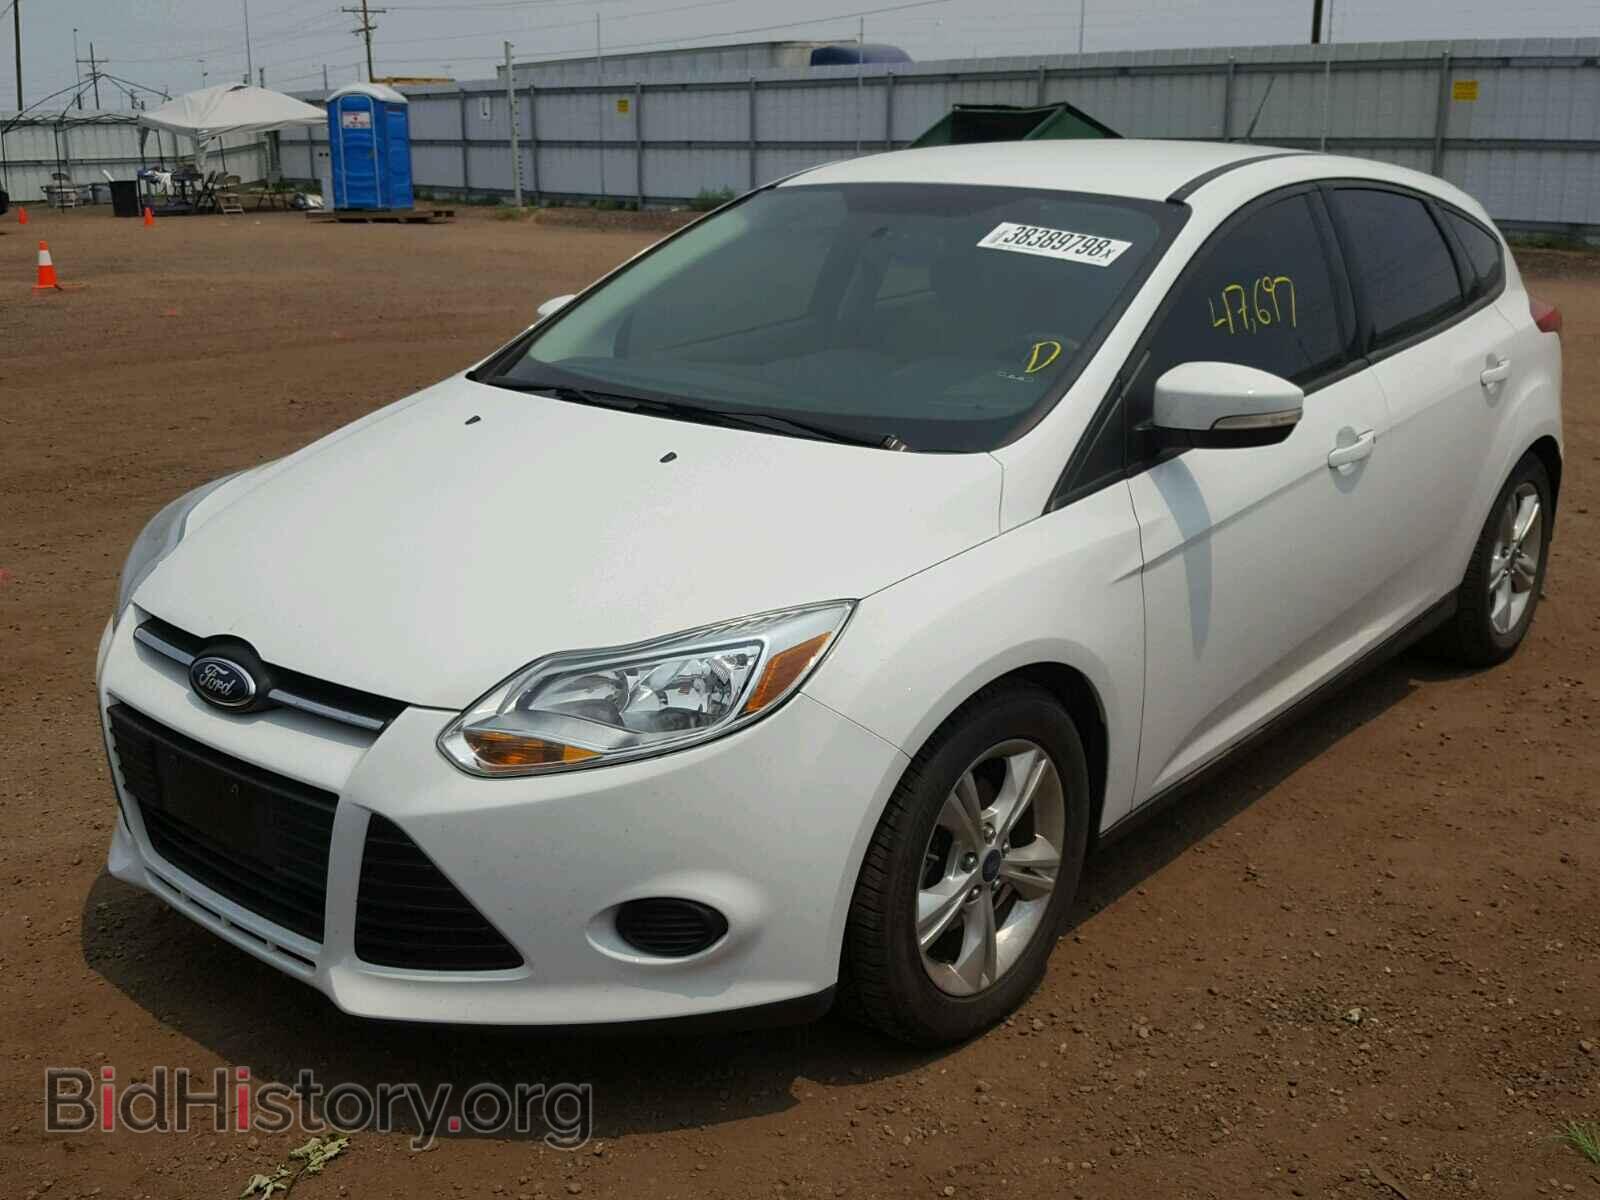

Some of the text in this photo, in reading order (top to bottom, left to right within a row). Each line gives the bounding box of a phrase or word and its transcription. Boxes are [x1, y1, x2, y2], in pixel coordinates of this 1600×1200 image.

[1208, 276, 1296, 335] 47,697
[1025, 340, 1061, 373] D
[200, 664, 236, 696] Ford
